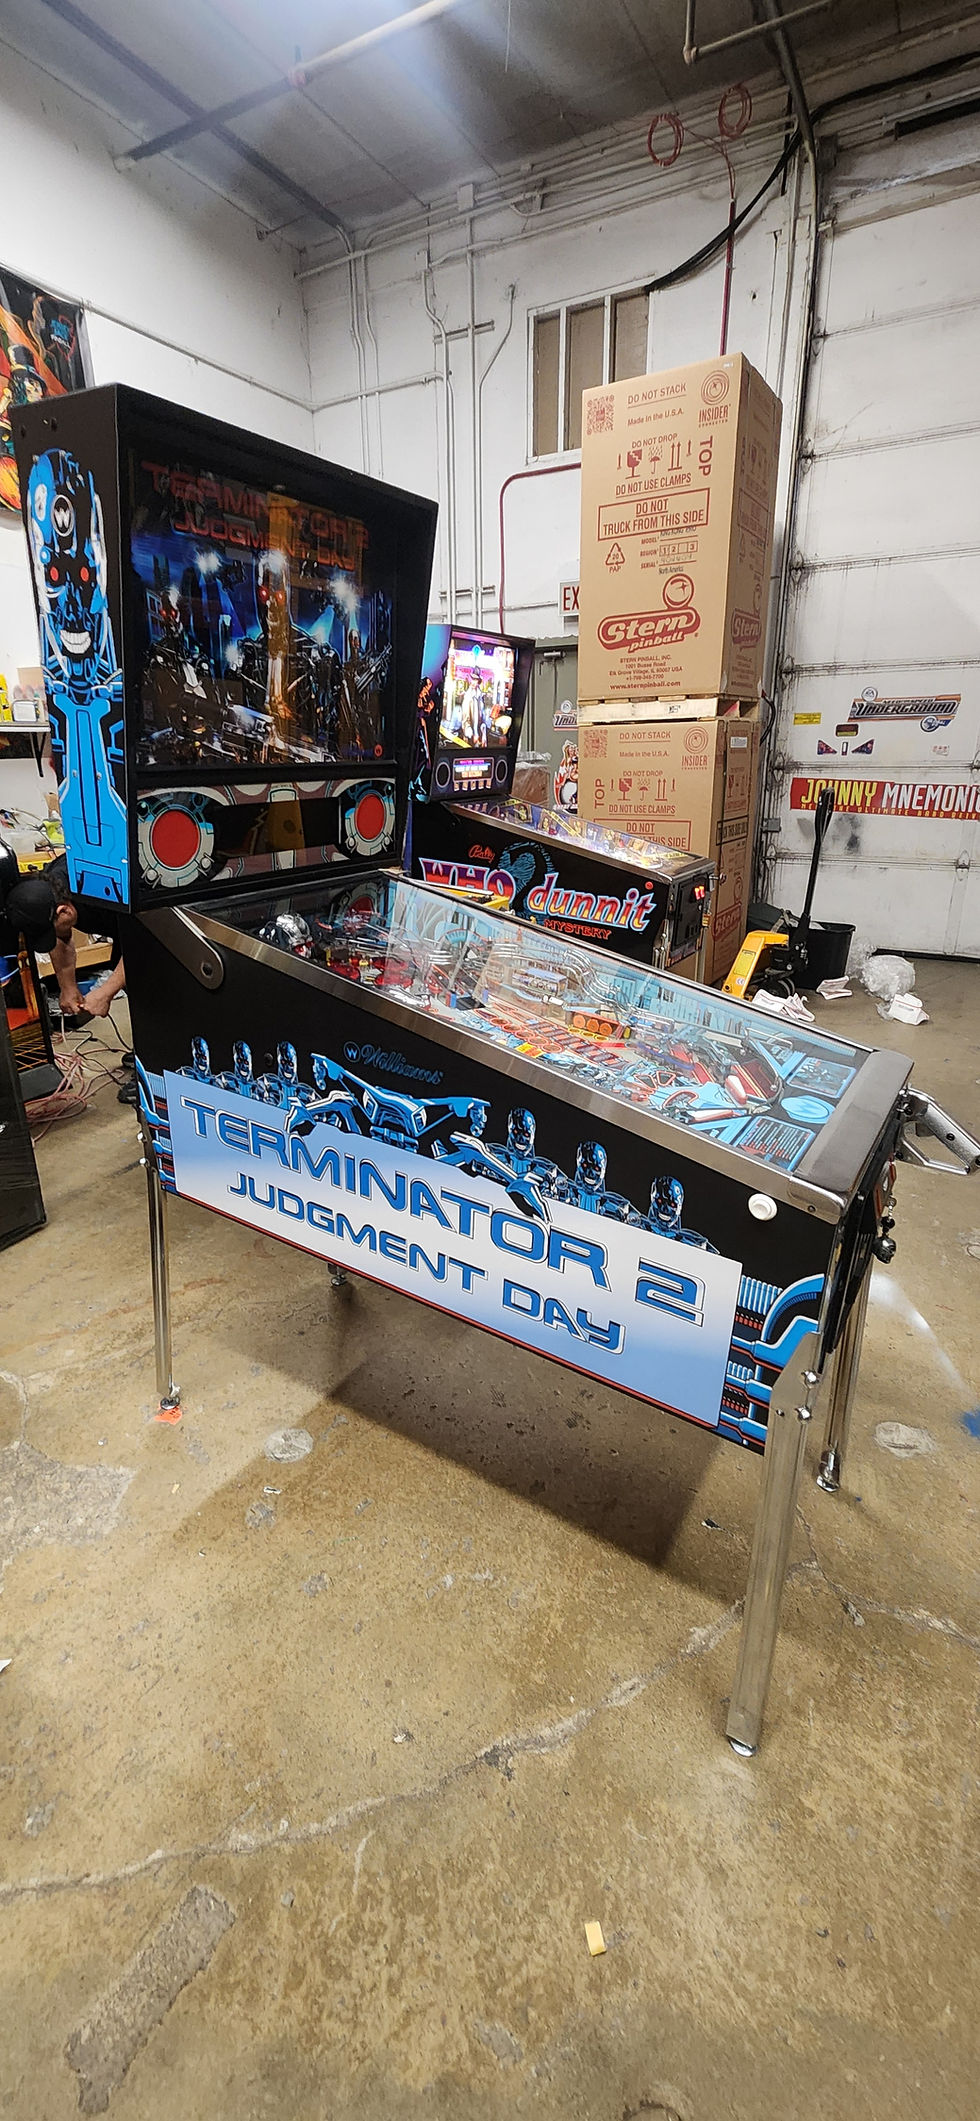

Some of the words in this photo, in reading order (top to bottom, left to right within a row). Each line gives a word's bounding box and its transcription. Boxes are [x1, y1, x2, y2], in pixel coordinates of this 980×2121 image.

[628, 393, 640, 404] DO
[642, 388, 658, 402] NOT
[660, 383, 686, 397] STACK
[628, 418, 644, 426] Made
[699, 405, 728, 422] INSIDER
[643, 438, 657, 447] NOT
[658, 433, 677, 443] DROP
[699, 436, 713, 476] TOP
[616, 485, 626, 496] DO
[628, 482, 642, 494] NOT
[644, 478, 659, 490] USE
[660, 473, 691, 488] CLAMPS
[636, 502, 648, 514] DO
[651, 498, 668, 512] NOT
[604, 522, 630, 535] TRUCK
[633, 516, 659, 530] FROM
[661, 512, 680, 526] THIS
[683, 509, 704, 523] SIDE
[607, 613, 690, 644] Stern
[629, 632, 684, 653] pinball
[682, 755, 708, 766] INSIDER
[594, 778, 605, 809] TOP
[609, 805, 618, 813] DO
[620, 805, 632, 813] NOT
[634, 805, 647, 813] USE
[649, 805, 675, 814] CLAMPS
[626, 823, 637, 832] DO
[639, 823, 655, 832] NOT
[668, 836, 686, 848] SIDE
[468, 844, 496, 863] Bally
[528, 872, 658, 932] dunnit
[543, 918, 612, 940] MYSTERY
[361, 1044, 444, 1085] Williams
[179, 1094, 611, 1292] TERMINATOR
[634, 1256, 706, 1328] 2
[226, 1171, 488, 1298] JUDGMENT
[501, 1277, 627, 1355] DAY
